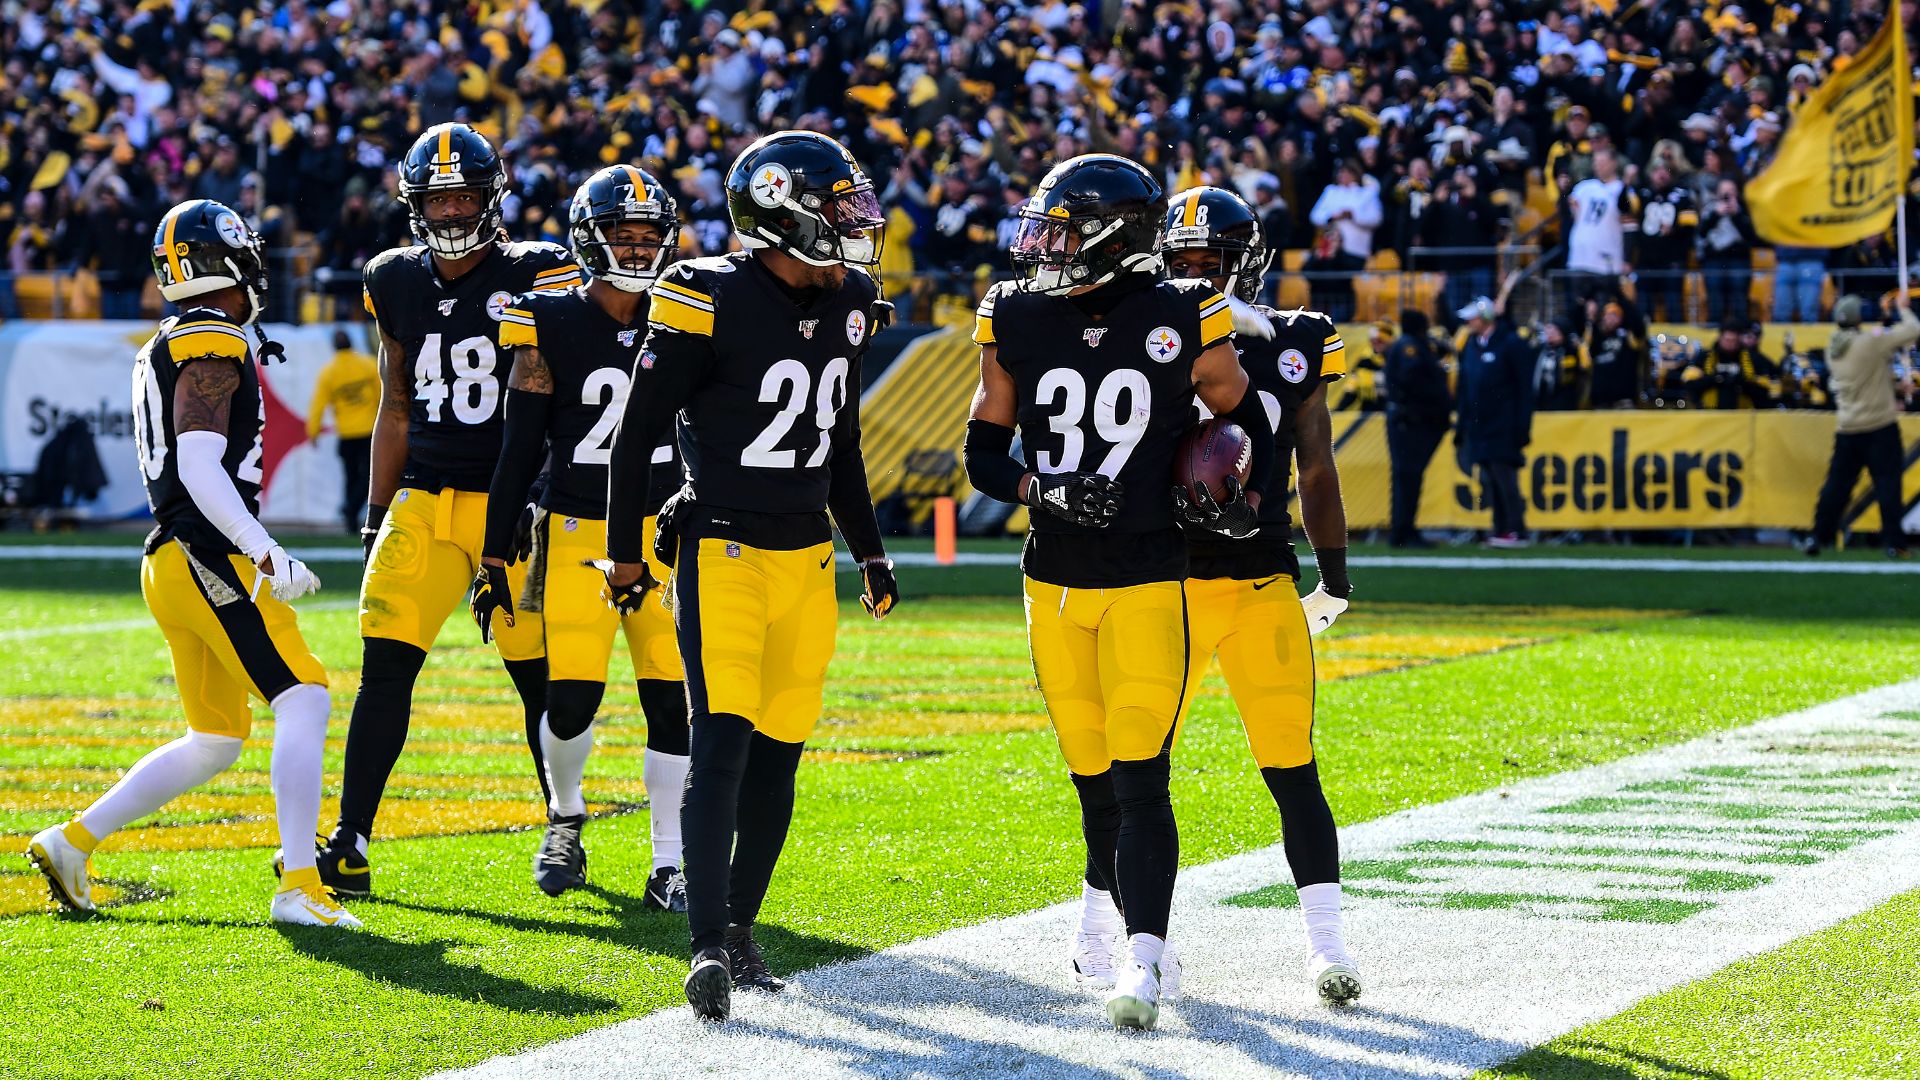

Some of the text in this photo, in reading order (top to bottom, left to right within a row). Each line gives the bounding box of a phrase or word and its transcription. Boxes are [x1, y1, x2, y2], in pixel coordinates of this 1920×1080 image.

[429, 151, 461, 174] 48
[623, 184, 658, 202] 22
[1172, 205, 1209, 228] 28
[163, 258, 194, 285] 20
[414, 333, 500, 425] 48
[740, 357, 849, 468] 29
[1035, 367, 1152, 481] 39
[1454, 427, 1743, 512] Seelers
[1044, 492, 1068, 510] adidas
